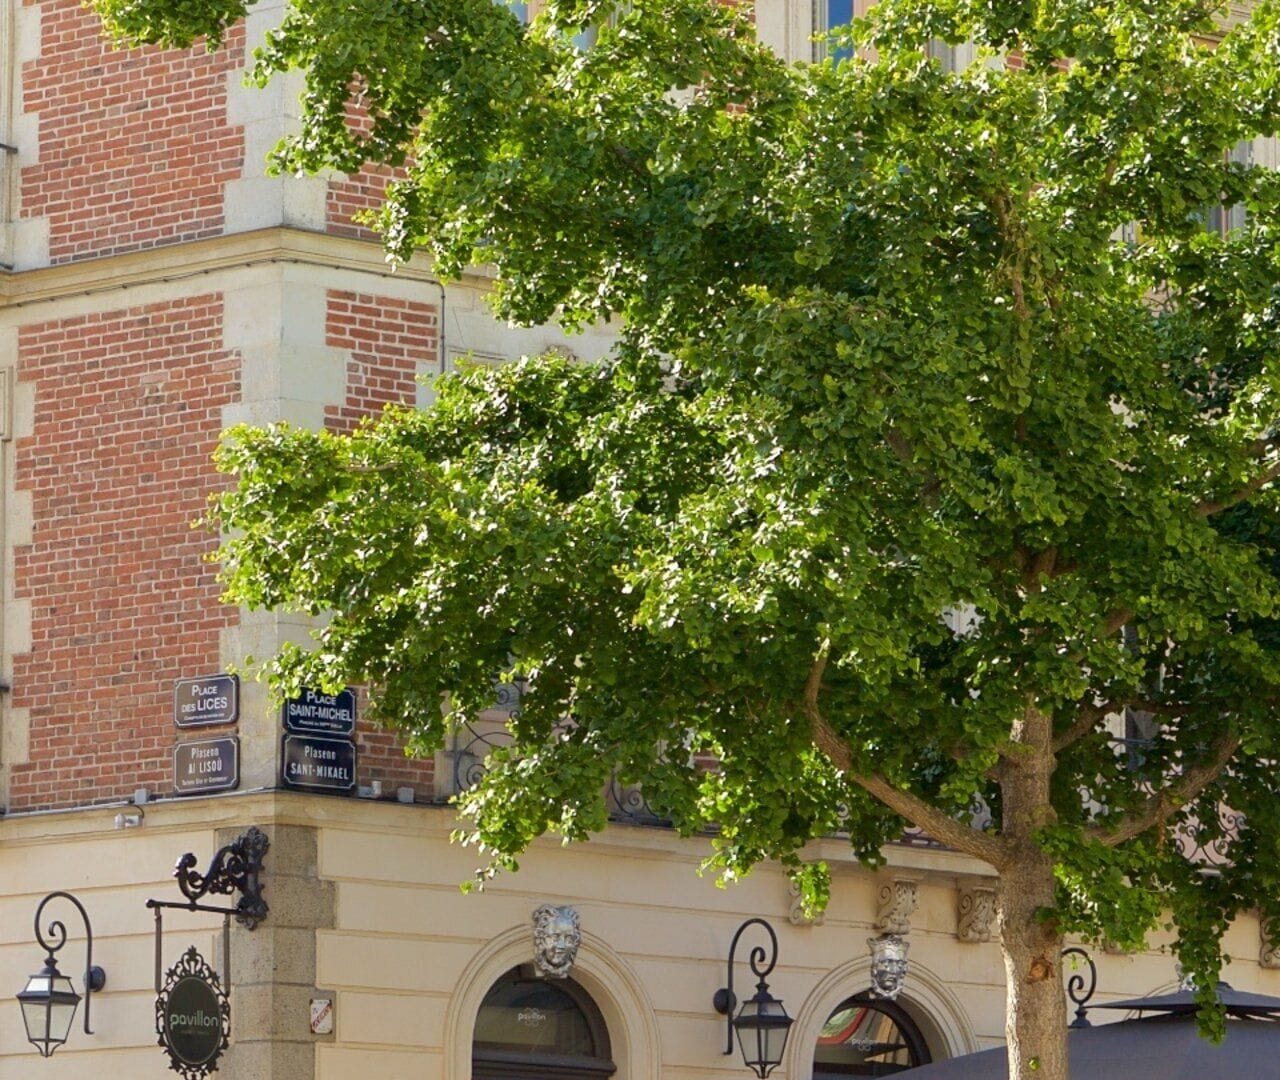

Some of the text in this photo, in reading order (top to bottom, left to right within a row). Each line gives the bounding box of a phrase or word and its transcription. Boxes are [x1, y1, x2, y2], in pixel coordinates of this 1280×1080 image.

[197, 696, 228, 712] LICES
[289, 703, 352, 722] SAINT-MICHEL
[290, 762, 349, 780] SANT-MIKAEL
[170, 1010, 219, 1029] pavillon
